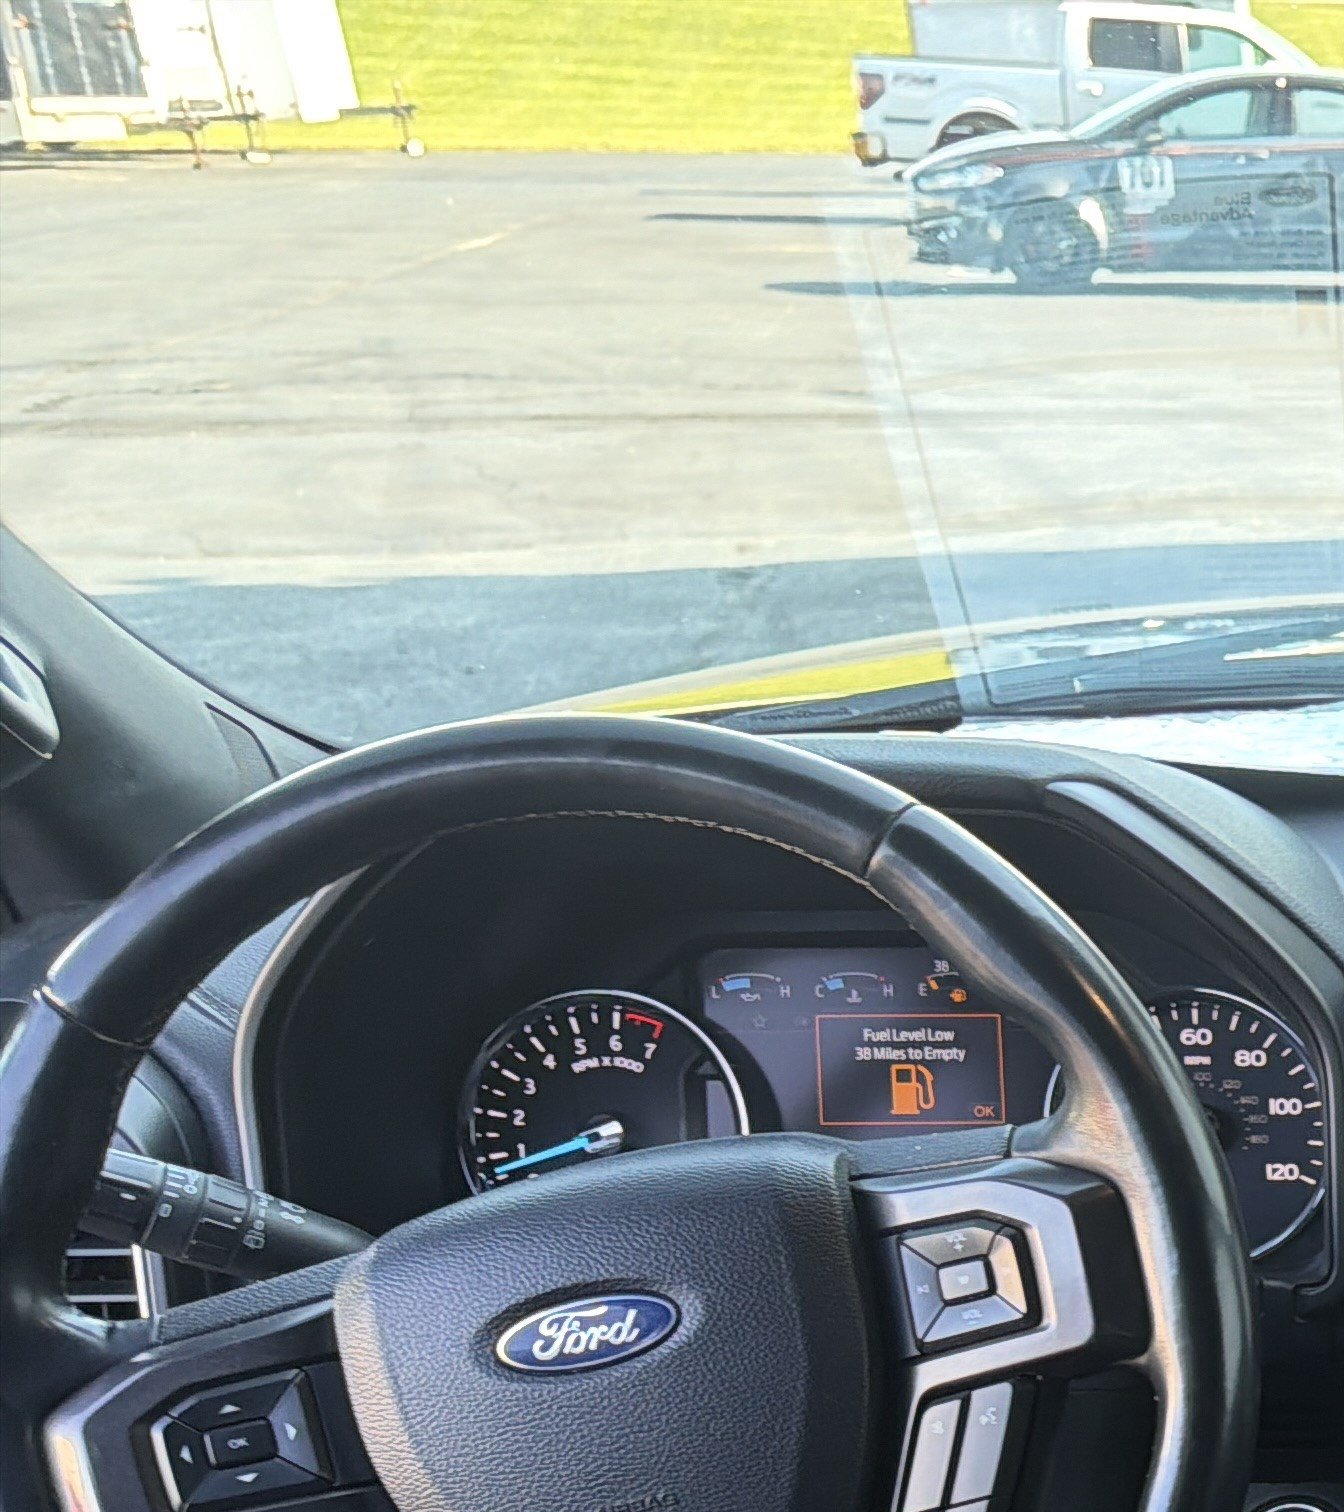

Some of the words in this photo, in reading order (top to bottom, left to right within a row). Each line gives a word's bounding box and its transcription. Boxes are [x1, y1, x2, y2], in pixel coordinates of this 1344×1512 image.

[933, 959, 950, 973] 38
[711, 985, 722, 999] L
[780, 985, 791, 998] H
[814, 984, 826, 998] C
[882, 984, 894, 998] H
[917, 982, 928, 997] E
[609, 1034, 623, 1052] 6
[863, 1028, 891, 1042] Fuel
[892, 1028, 927, 1041] Level
[928, 1028, 955, 1041] Low
[1179, 1028, 1213, 1046] 60
[573, 1038, 587, 1055] 5
[643, 1042, 657, 1060] 7
[855, 1046, 872, 1060] 38
[873, 1046, 906, 1060] Miles
[907, 1047, 922, 1060] to
[923, 1046, 966, 1062] Empty
[542, 1053, 557, 1070] 4
[570, 1056, 600, 1074] RPM
[1234, 1050, 1267, 1067] 80
[523, 1077, 537, 1095] 3
[973, 1105, 995, 1118] OK
[1268, 1097, 1302, 1115] 100
[512, 1109, 527, 1126] 2
[516, 1142, 526, 1158] 1
[1265, 1163, 1300, 1181] 120
[532, 1305, 640, 1361] Ford
[226, 1436, 249, 1449] OK
